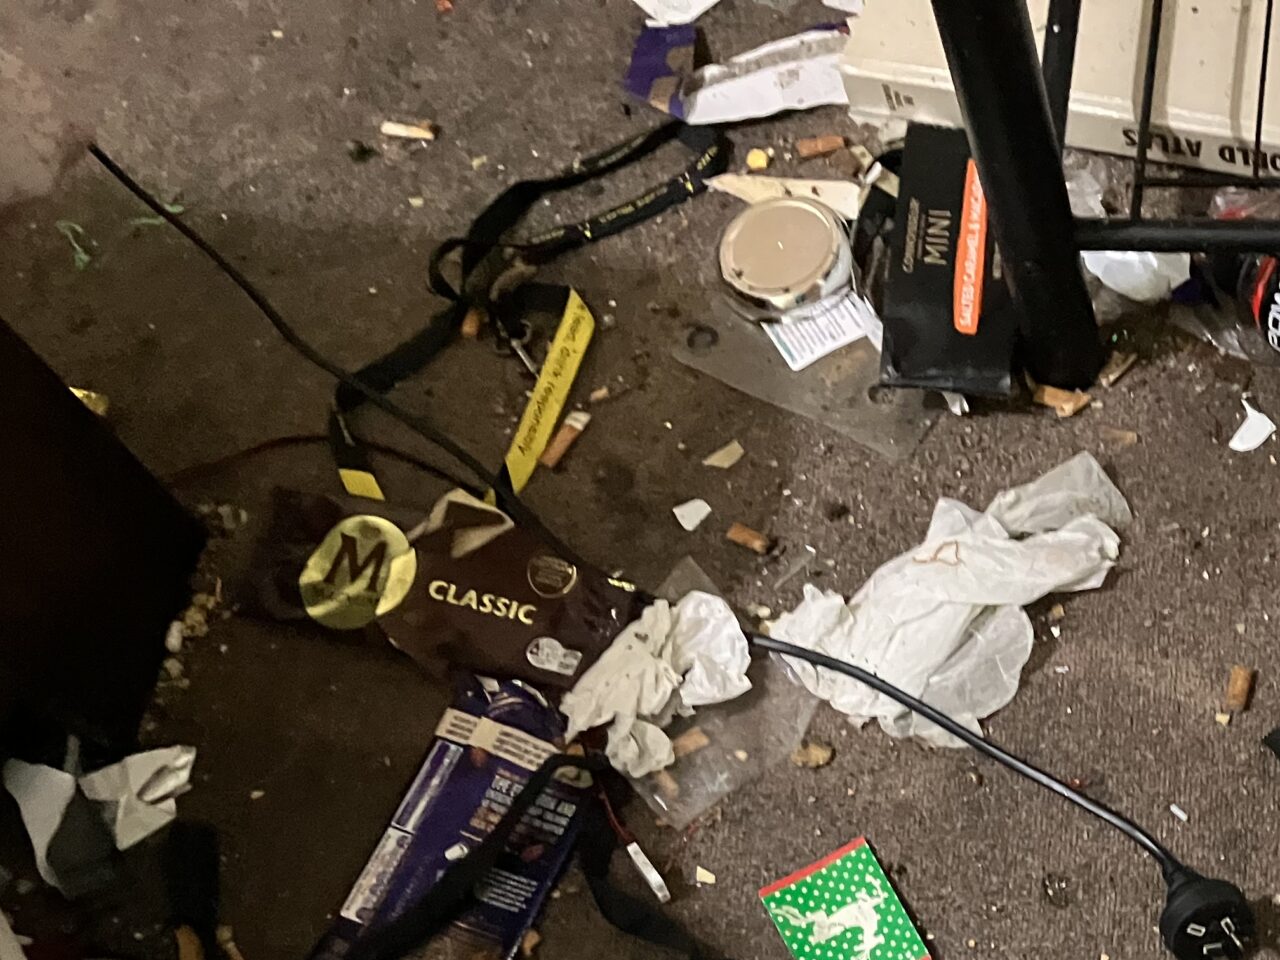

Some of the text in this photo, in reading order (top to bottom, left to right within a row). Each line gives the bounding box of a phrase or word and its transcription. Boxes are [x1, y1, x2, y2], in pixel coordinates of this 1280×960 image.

[1122, 126, 1202, 158] ATLS
[923, 209, 951, 265] MINI
[518, 380, 555, 457] responsibly
[323, 531, 388, 594] M
[428, 579, 538, 625] CLASSIC
